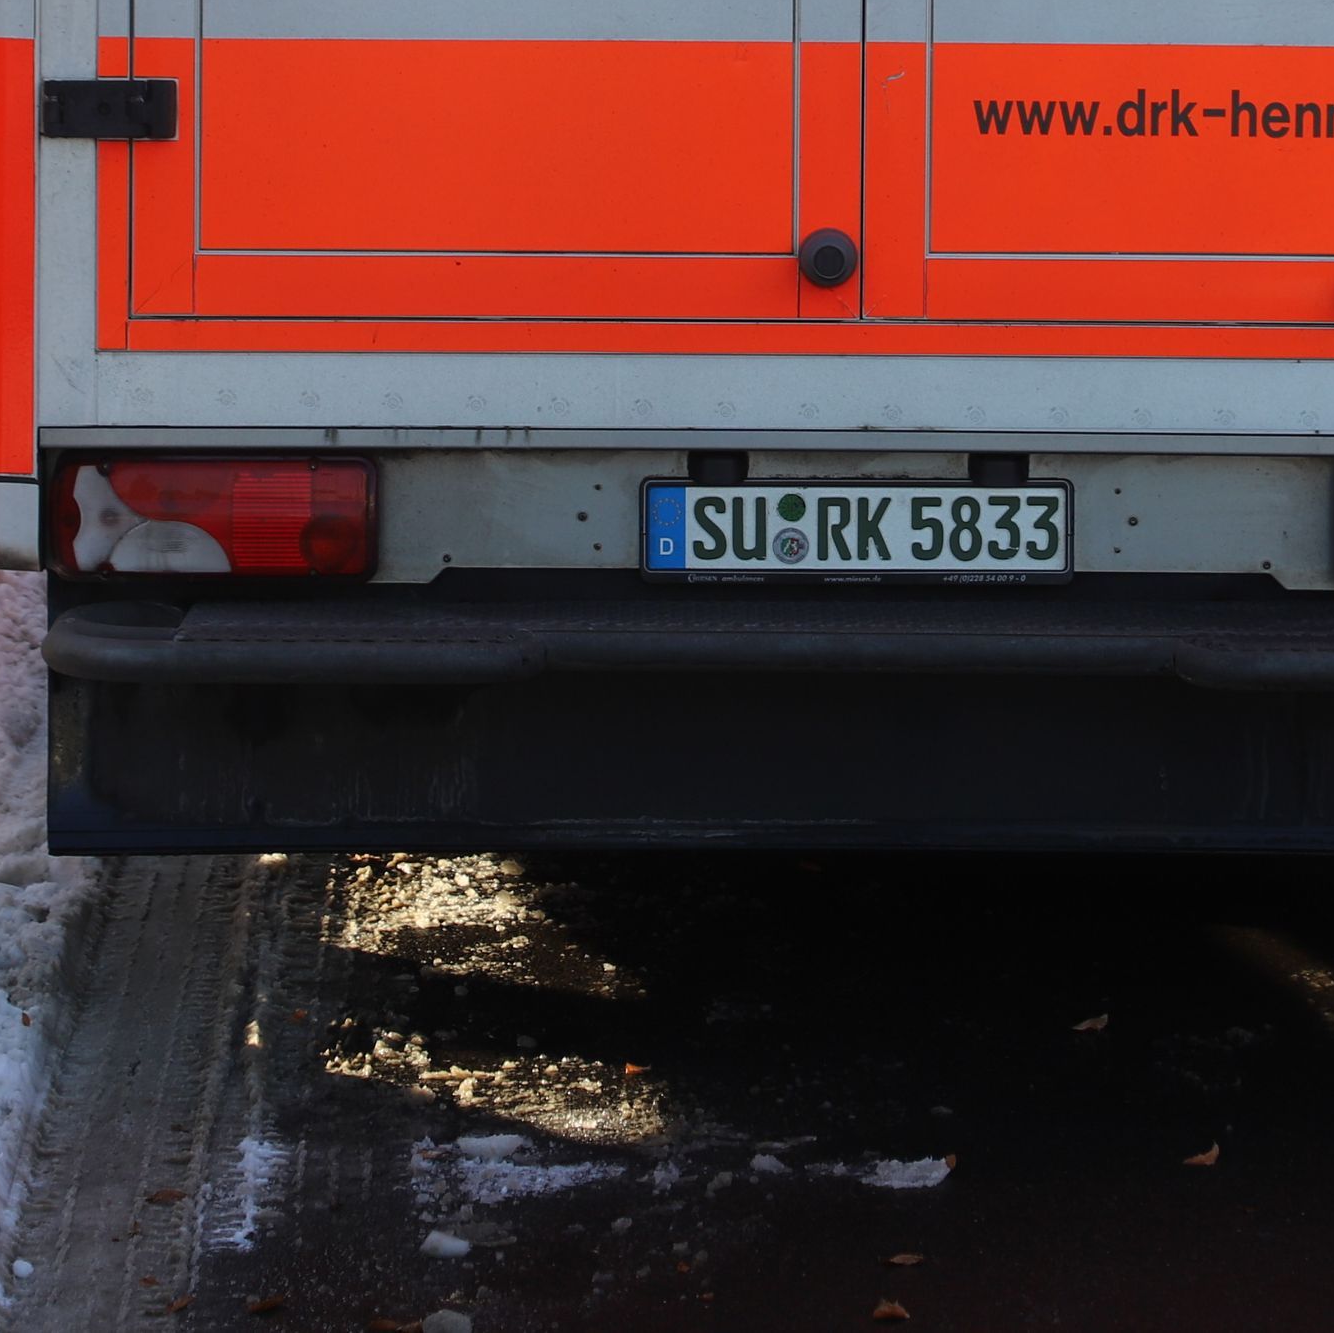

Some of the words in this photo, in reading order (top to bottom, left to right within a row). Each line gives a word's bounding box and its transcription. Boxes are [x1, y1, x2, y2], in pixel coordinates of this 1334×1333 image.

[693, 497, 766, 561] SU
[817, 497, 891, 561] RK
[911, 497, 1059, 561] 5833
[659, 537, 674, 555] D
[824, 574, 882, 583] www.miesen.de
